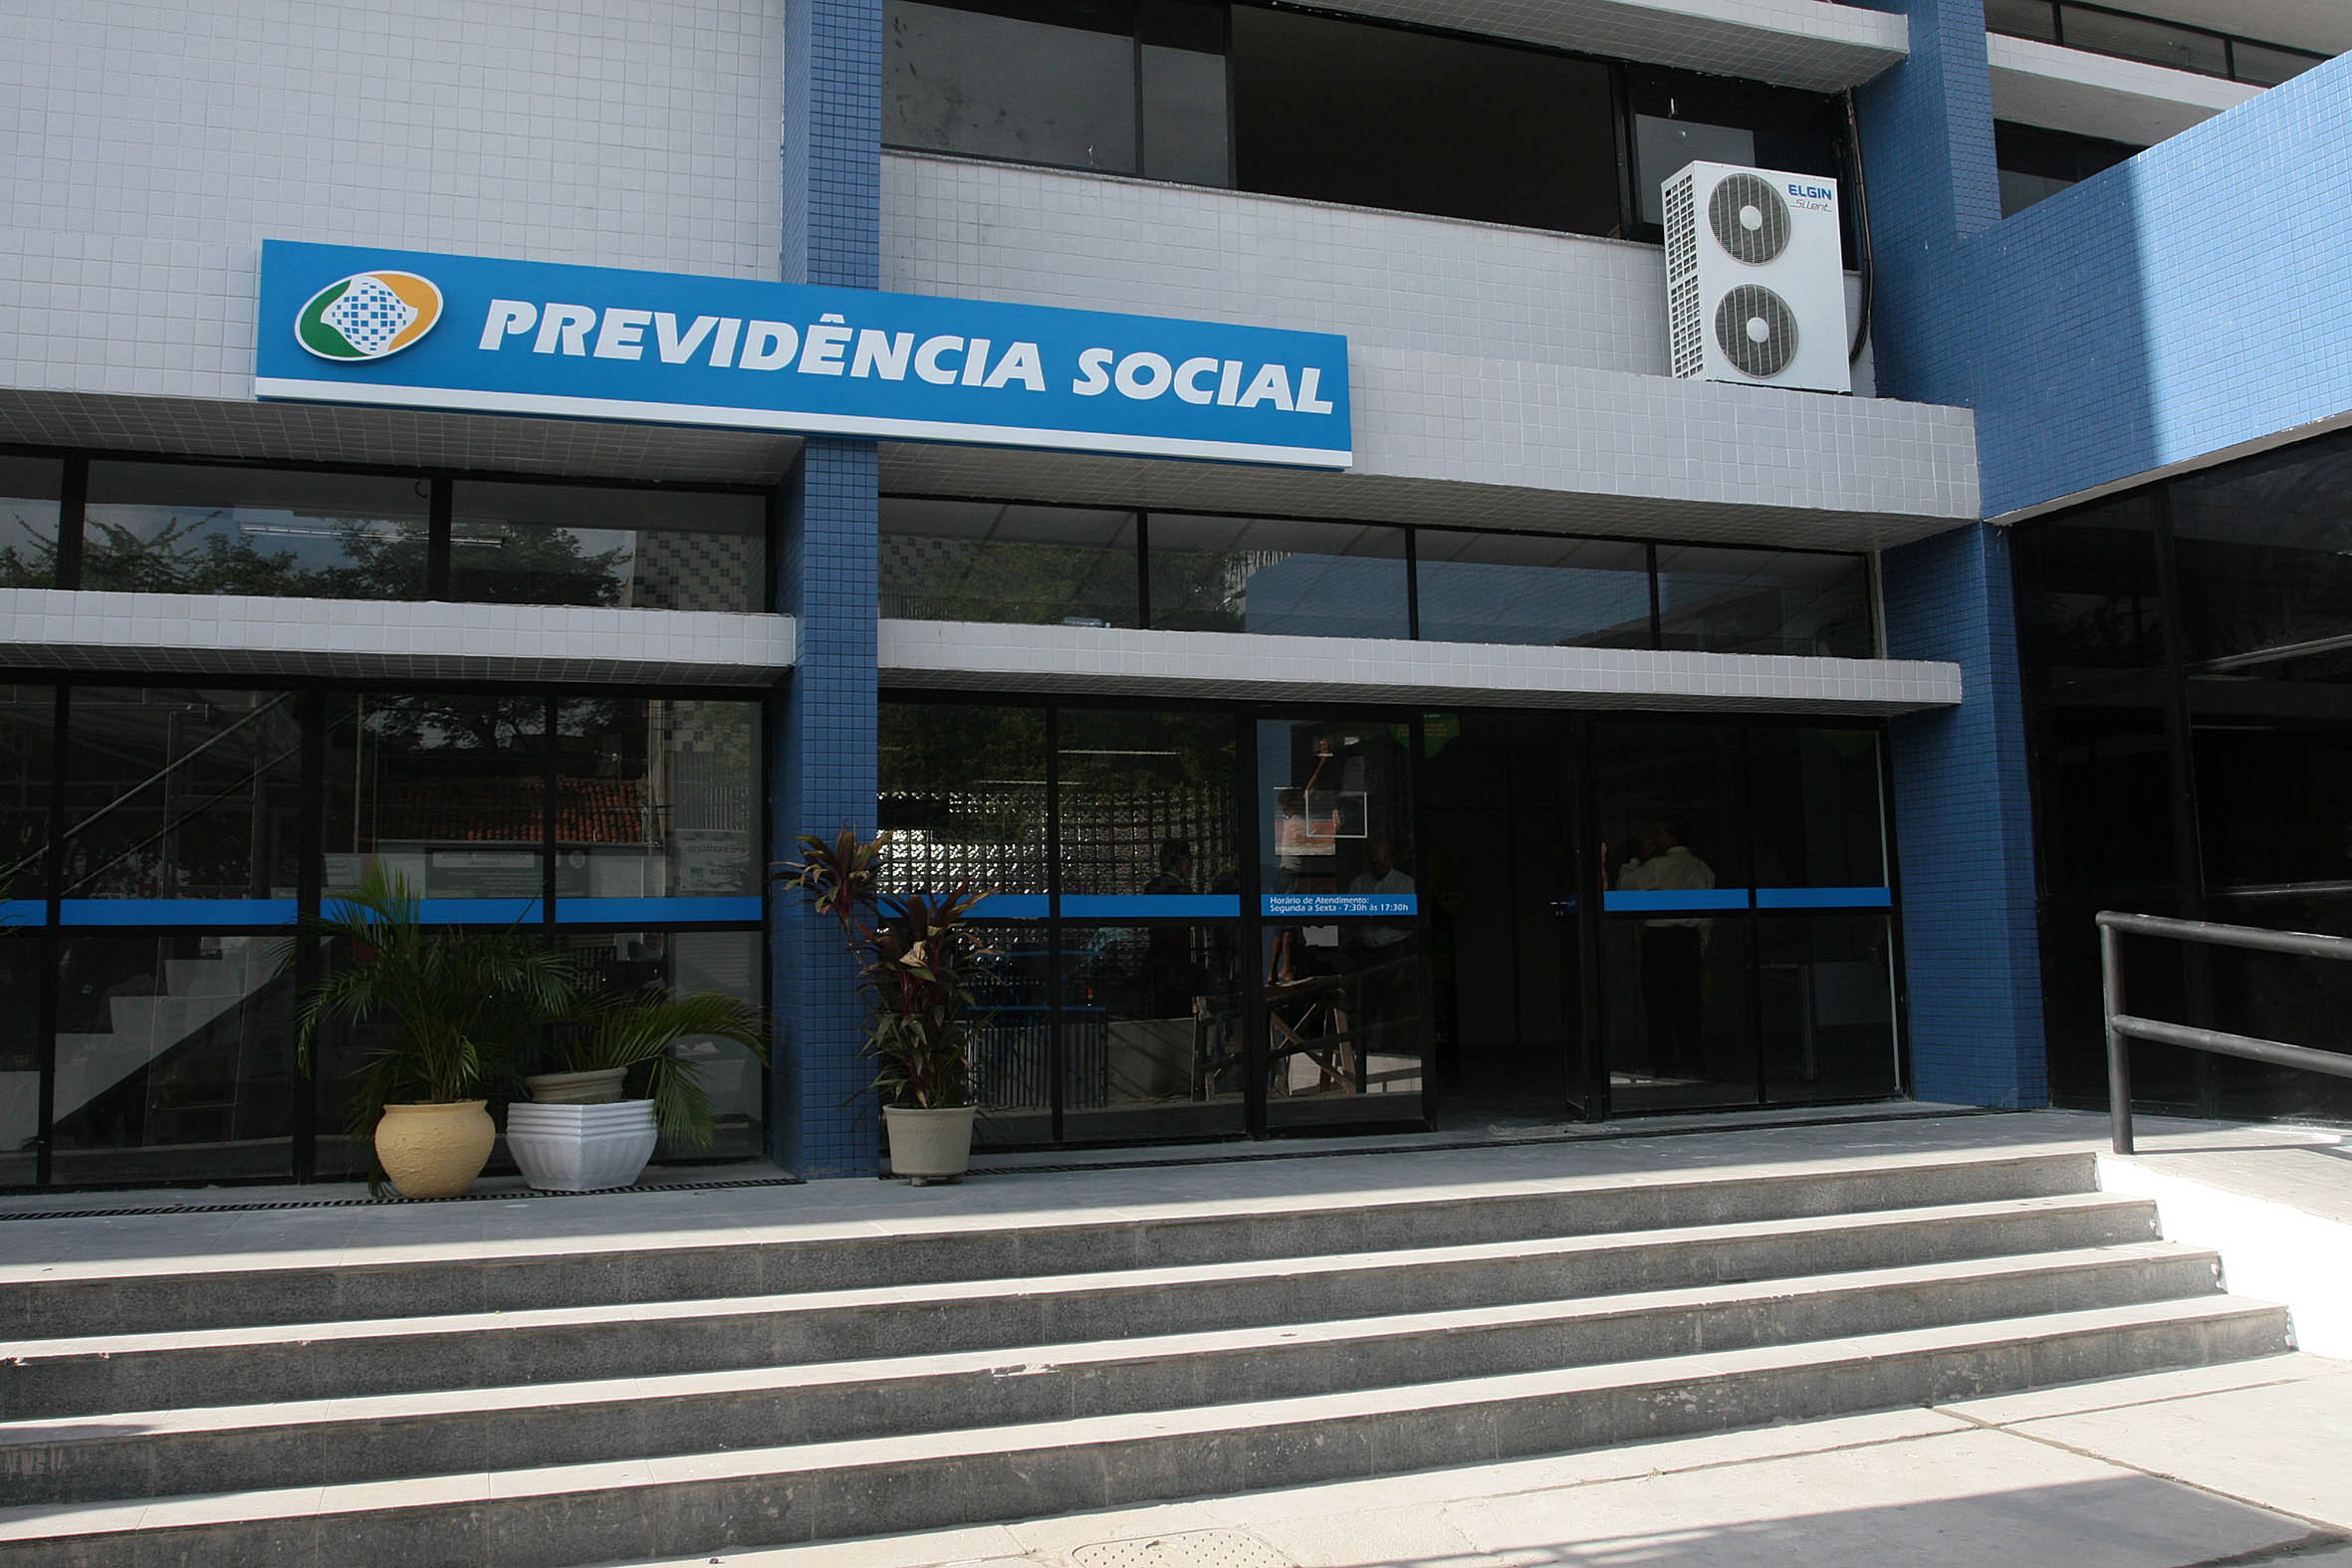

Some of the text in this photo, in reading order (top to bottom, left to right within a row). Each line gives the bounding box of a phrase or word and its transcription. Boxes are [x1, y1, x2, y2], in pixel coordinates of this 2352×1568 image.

[1788, 183, 1832, 200] ELGIN
[478, 299, 1333, 414] PREVIDÊNCIA SOCIAL
[1270, 904, 1305, 913] Segunda
